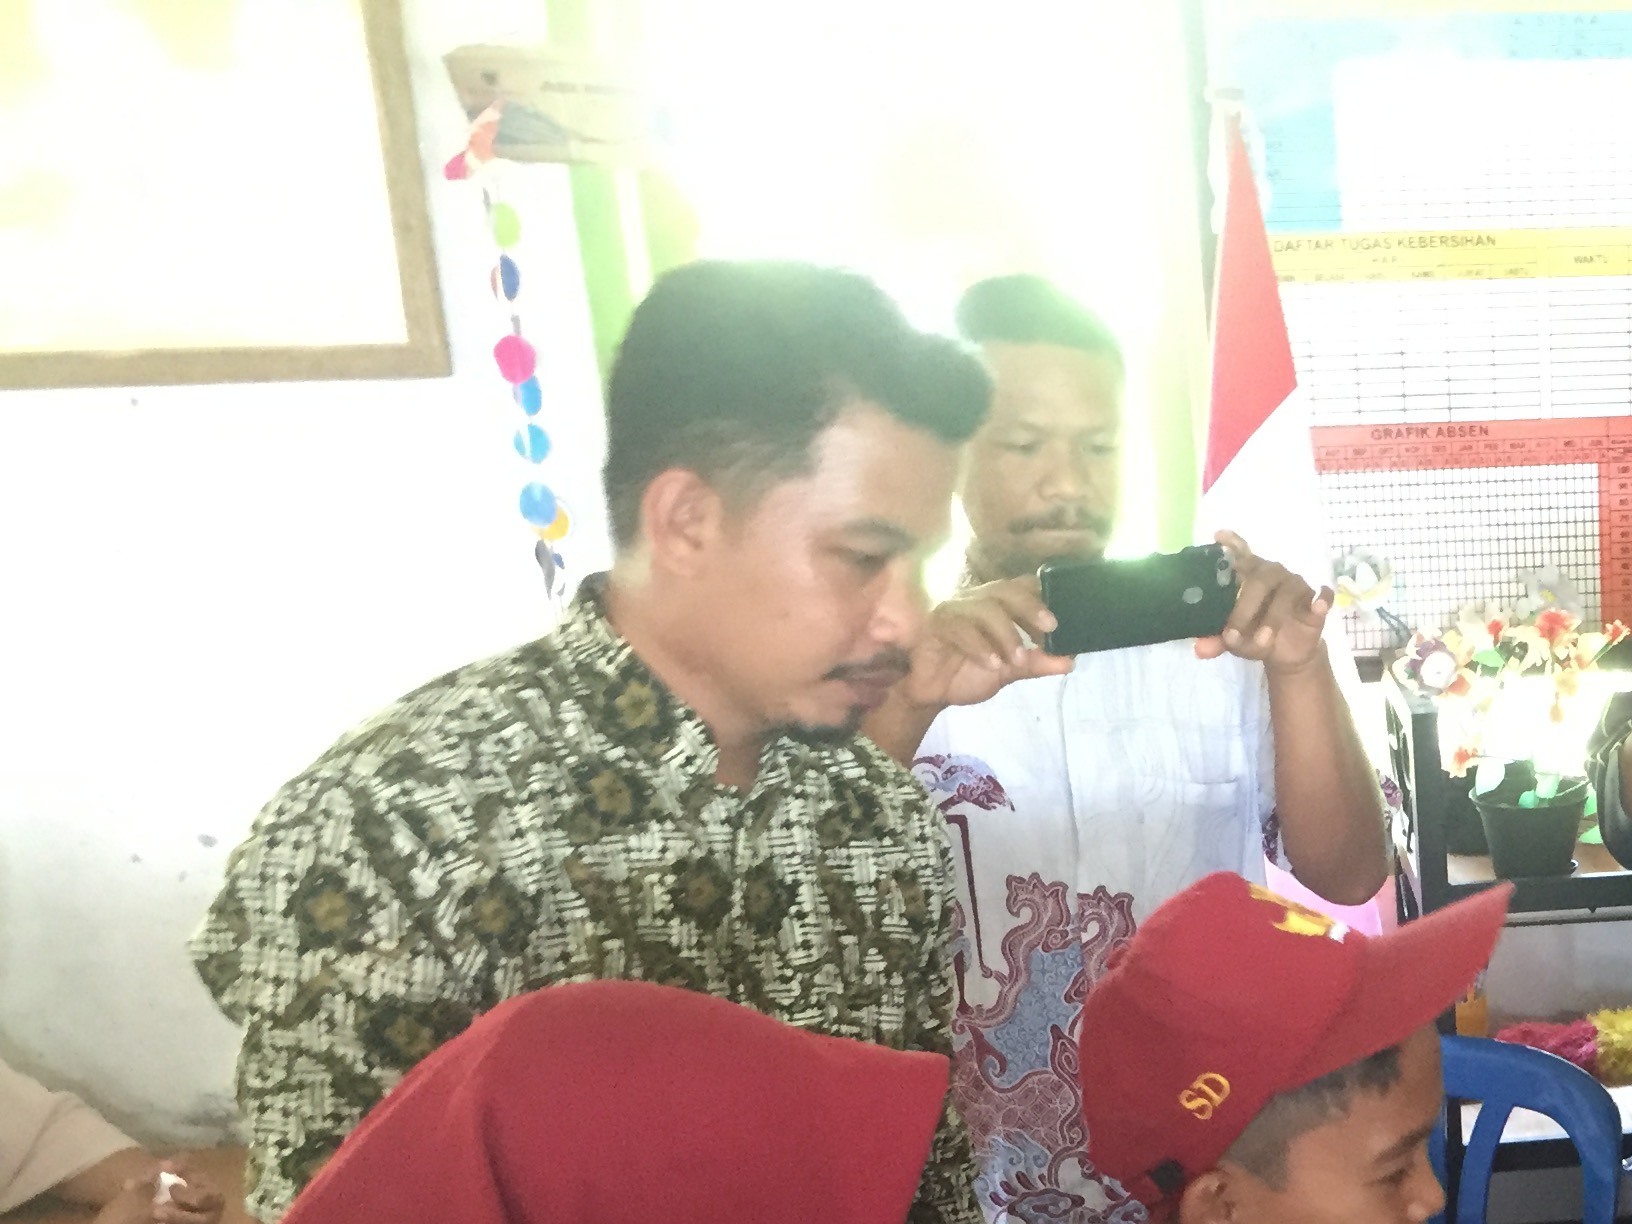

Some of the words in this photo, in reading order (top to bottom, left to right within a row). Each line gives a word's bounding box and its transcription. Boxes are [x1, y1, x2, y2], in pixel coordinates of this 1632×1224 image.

[1273, 239, 1334, 253] DAFTAR
[1340, 237, 1392, 251] TUGAS
[1397, 234, 1497, 249] KEBERSIHAN
[1370, 426, 1431, 441] GRAFIK
[1435, 424, 1490, 439] ABSEN
[1179, 1072, 1231, 1120] SD
